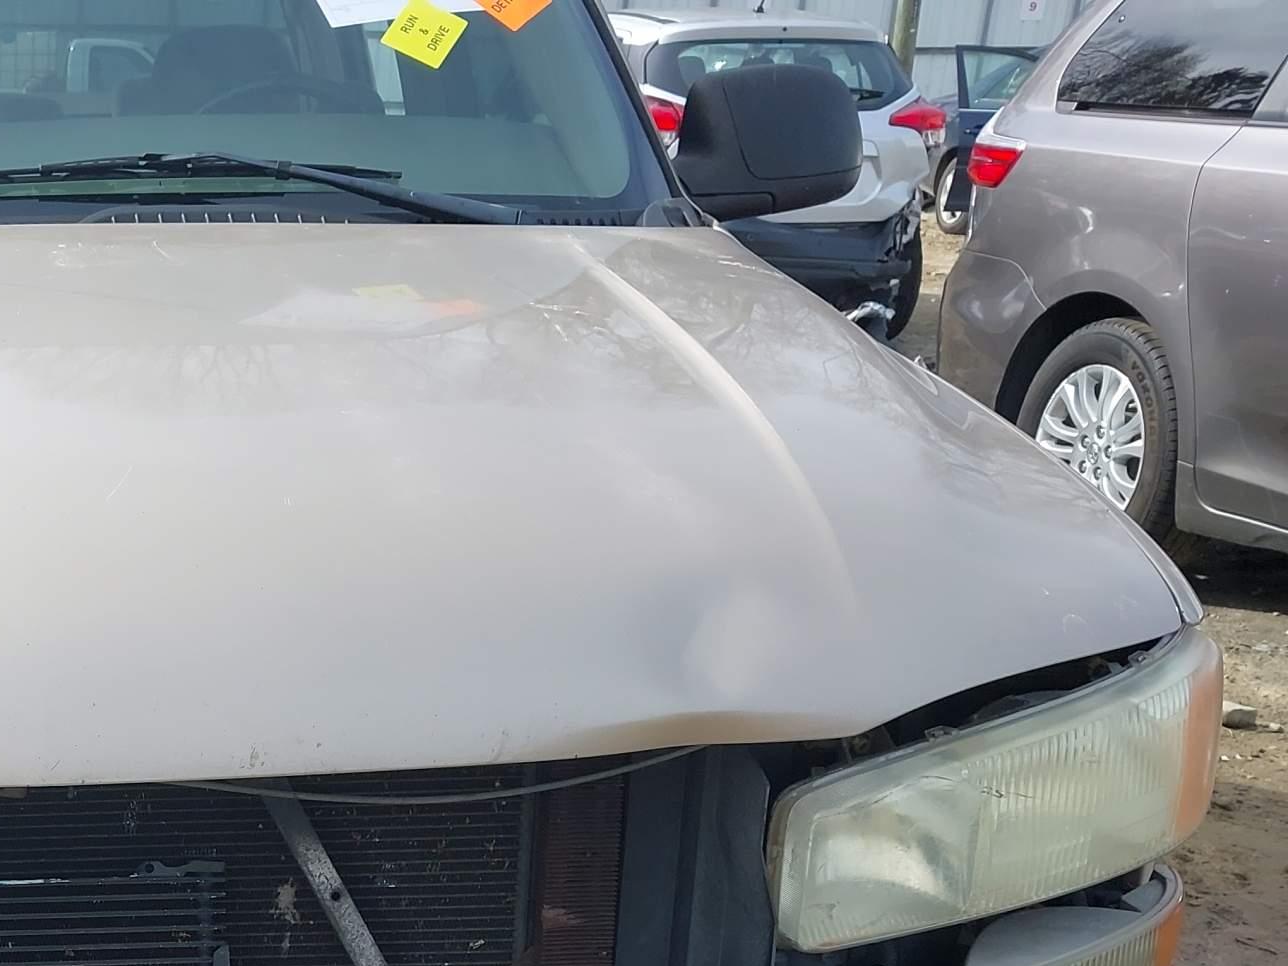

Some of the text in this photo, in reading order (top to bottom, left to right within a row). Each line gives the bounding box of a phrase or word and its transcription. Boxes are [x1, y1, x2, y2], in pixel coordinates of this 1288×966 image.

[491, 0, 513, 13] DET
[1028, 1, 1038, 12] 9
[399, 14, 419, 34] RUN
[418, 28, 430, 36] &
[426, 25, 450, 52] DRIVE
